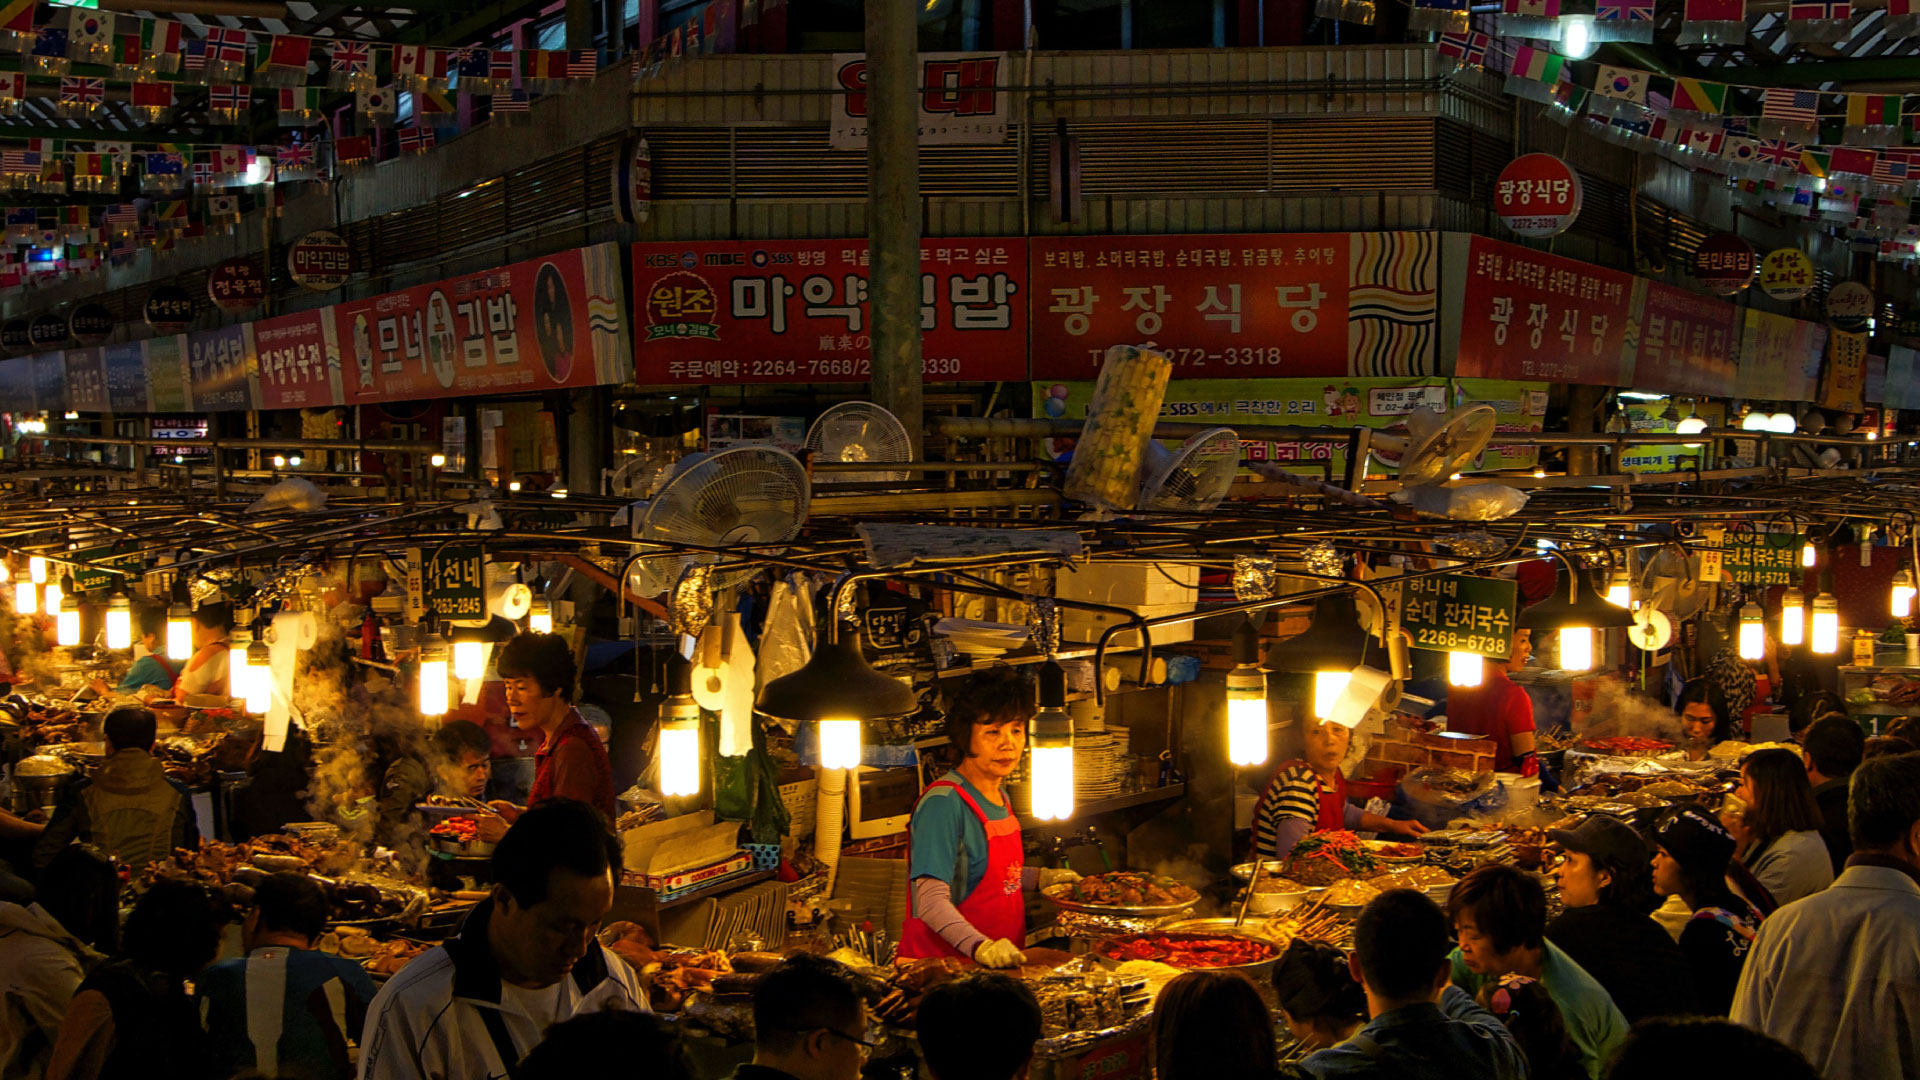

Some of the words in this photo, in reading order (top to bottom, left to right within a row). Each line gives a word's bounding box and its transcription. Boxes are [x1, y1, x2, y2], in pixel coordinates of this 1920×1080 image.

[1498, 179, 1571, 206] 광장식당
[296, 250, 351, 271] 마약김밥
[645, 253, 679, 268] KBS
[704, 252, 745, 267] MBC
[771, 252, 793, 265] SBS
[797, 250, 827, 266] 방영
[936, 248, 971, 266] 먹고
[1295, 247, 1336, 266] 추어탕
[1696, 251, 1751, 271] 복민회집
[1764, 269, 1809, 284] 보리밥
[215, 278, 264, 296] 정육점
[652, 285, 714, 318] 원조
[261, 342, 324, 386] 대광정육점
[1167, 347, 1282, 366] 272-3318
[1234, 399, 1281, 415] 극찬한
[1286, 400, 1317, 415] 요리
[1409, 575, 1458, 598] 하니네
[1405, 597, 1437, 625] 순대
[1443, 601, 1511, 634] 잔치국수
[1418, 627, 1506, 653] 2268-6738
